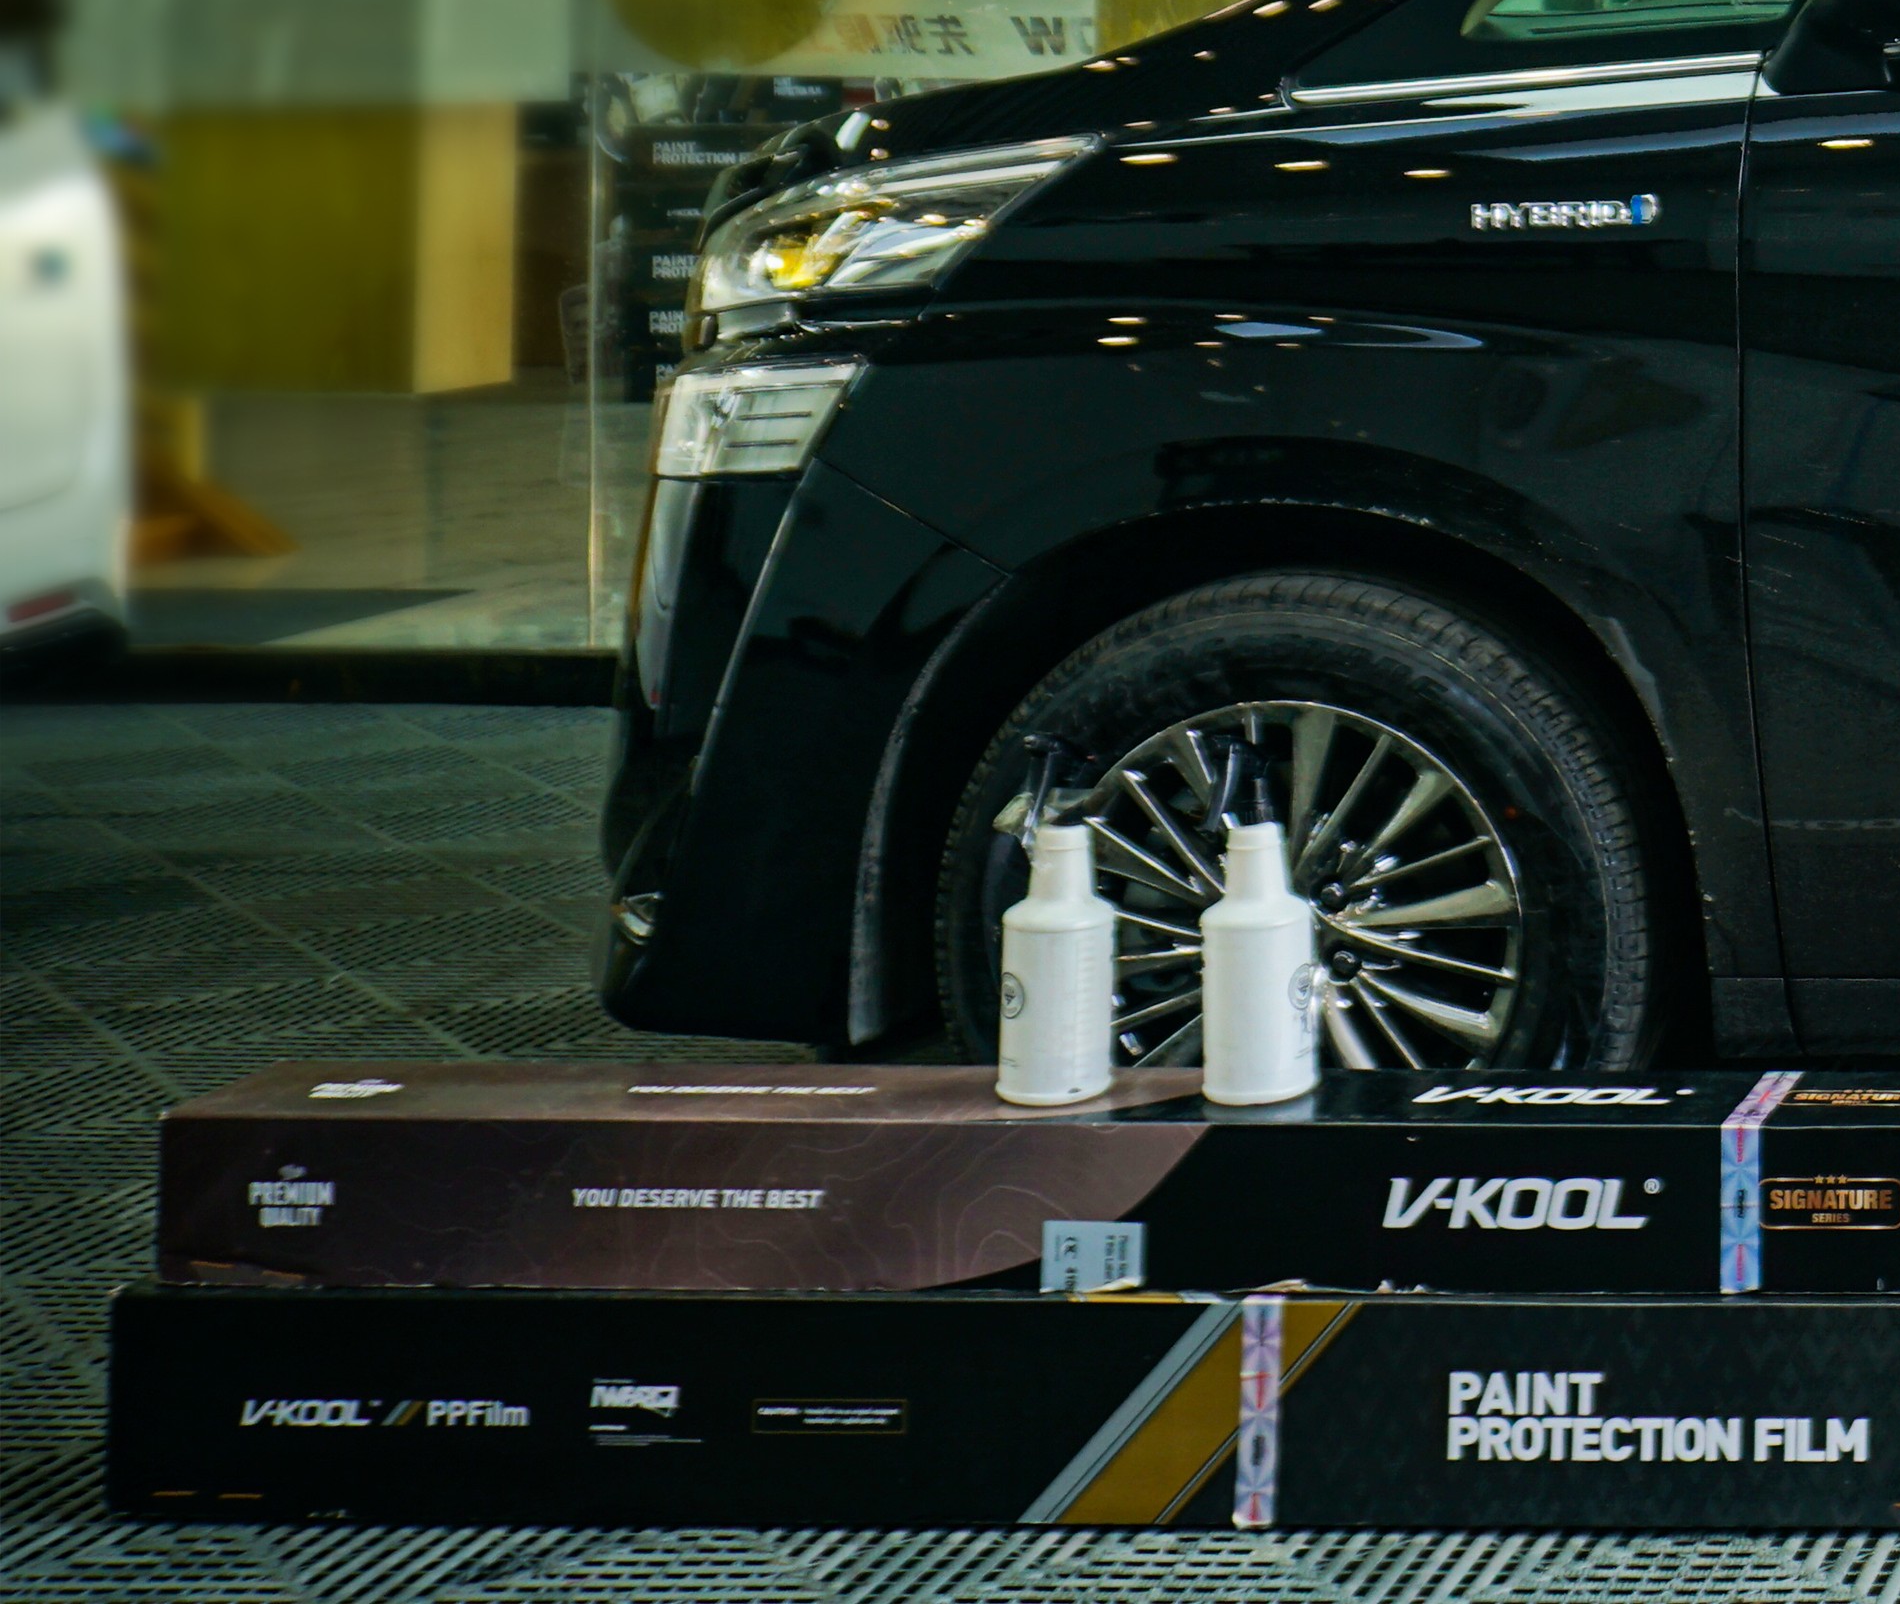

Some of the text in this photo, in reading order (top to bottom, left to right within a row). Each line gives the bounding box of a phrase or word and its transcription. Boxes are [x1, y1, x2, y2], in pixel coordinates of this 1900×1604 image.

[1470, 200, 1627, 229] HYBRID
[572, 1188, 826, 1210] YOU DESERVE THE BEST
[1769, 1189, 1893, 1212] SIGNATURE
[1811, 1212, 1851, 1225] SERIES
[1448, 1371, 1602, 1416] PAINT
[427, 1399, 530, 1427] PPFilm
[1447, 1416, 1869, 1463] PROTECTION FILM
